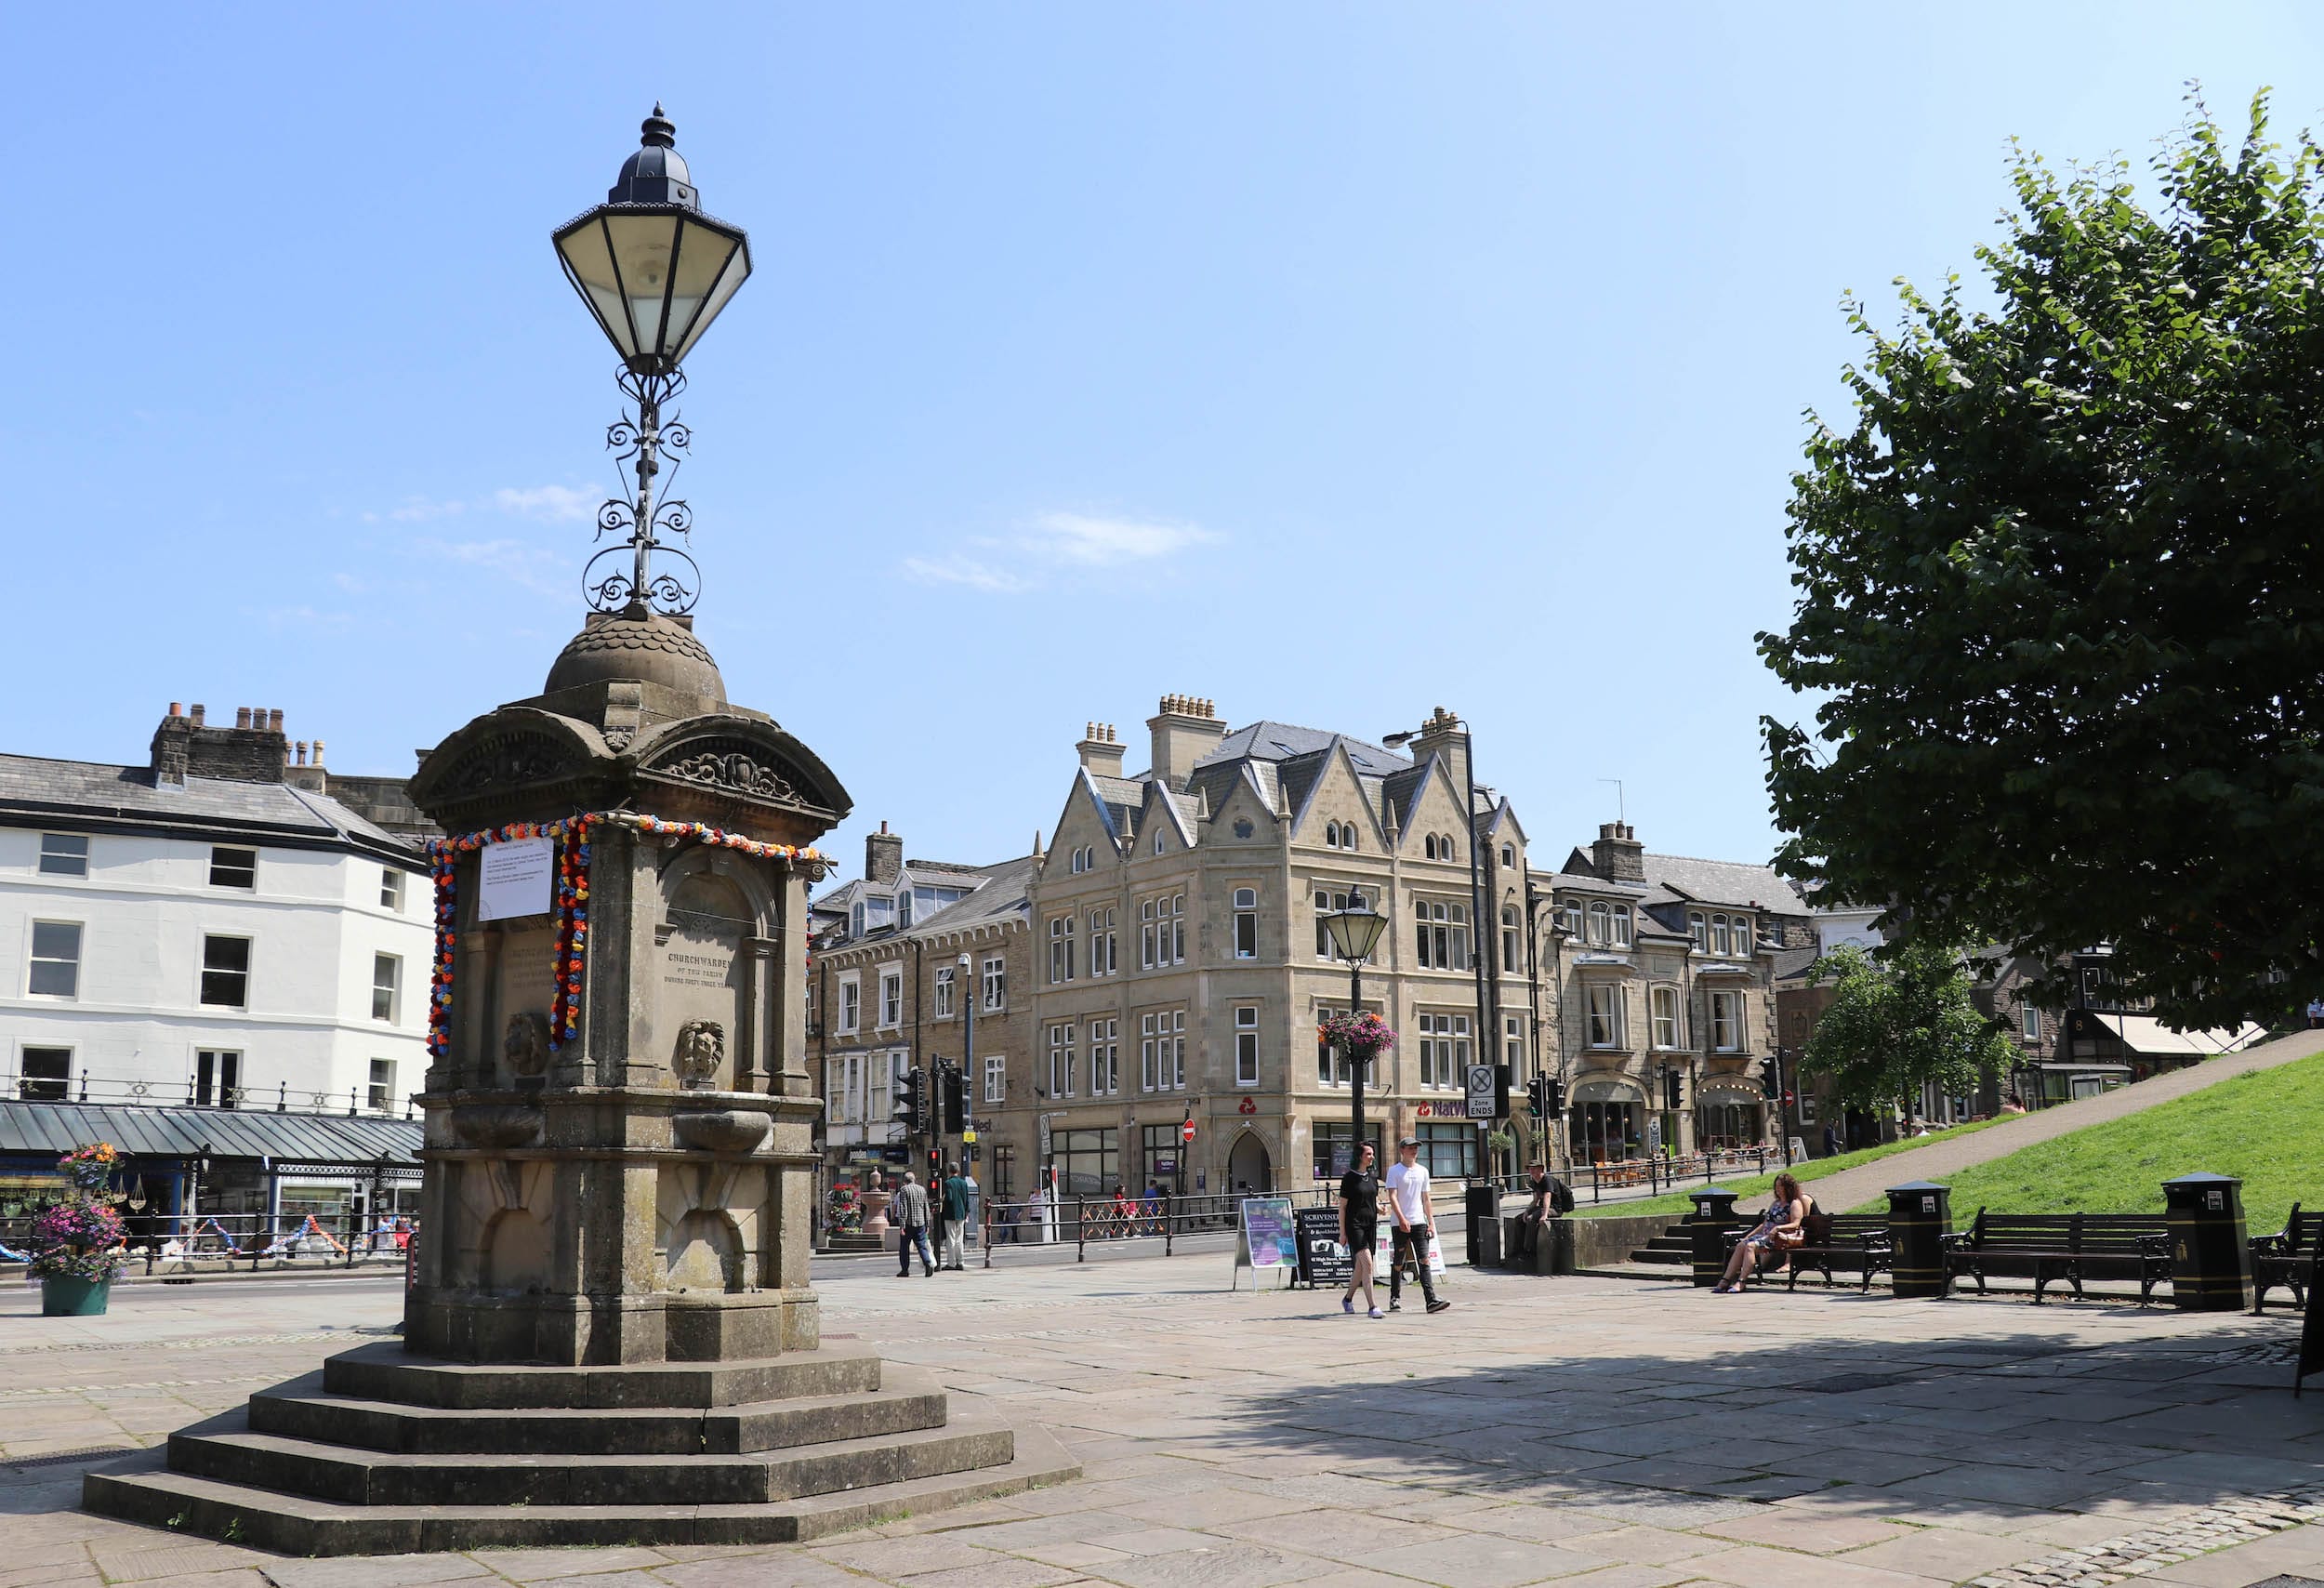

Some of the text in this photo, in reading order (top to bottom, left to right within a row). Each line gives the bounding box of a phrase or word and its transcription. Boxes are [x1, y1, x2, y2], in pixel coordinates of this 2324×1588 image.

[2076, 1020, 2083, 1031] 8
[1433, 1101, 1466, 1116] NatW
[971, 1118, 993, 1132] West
